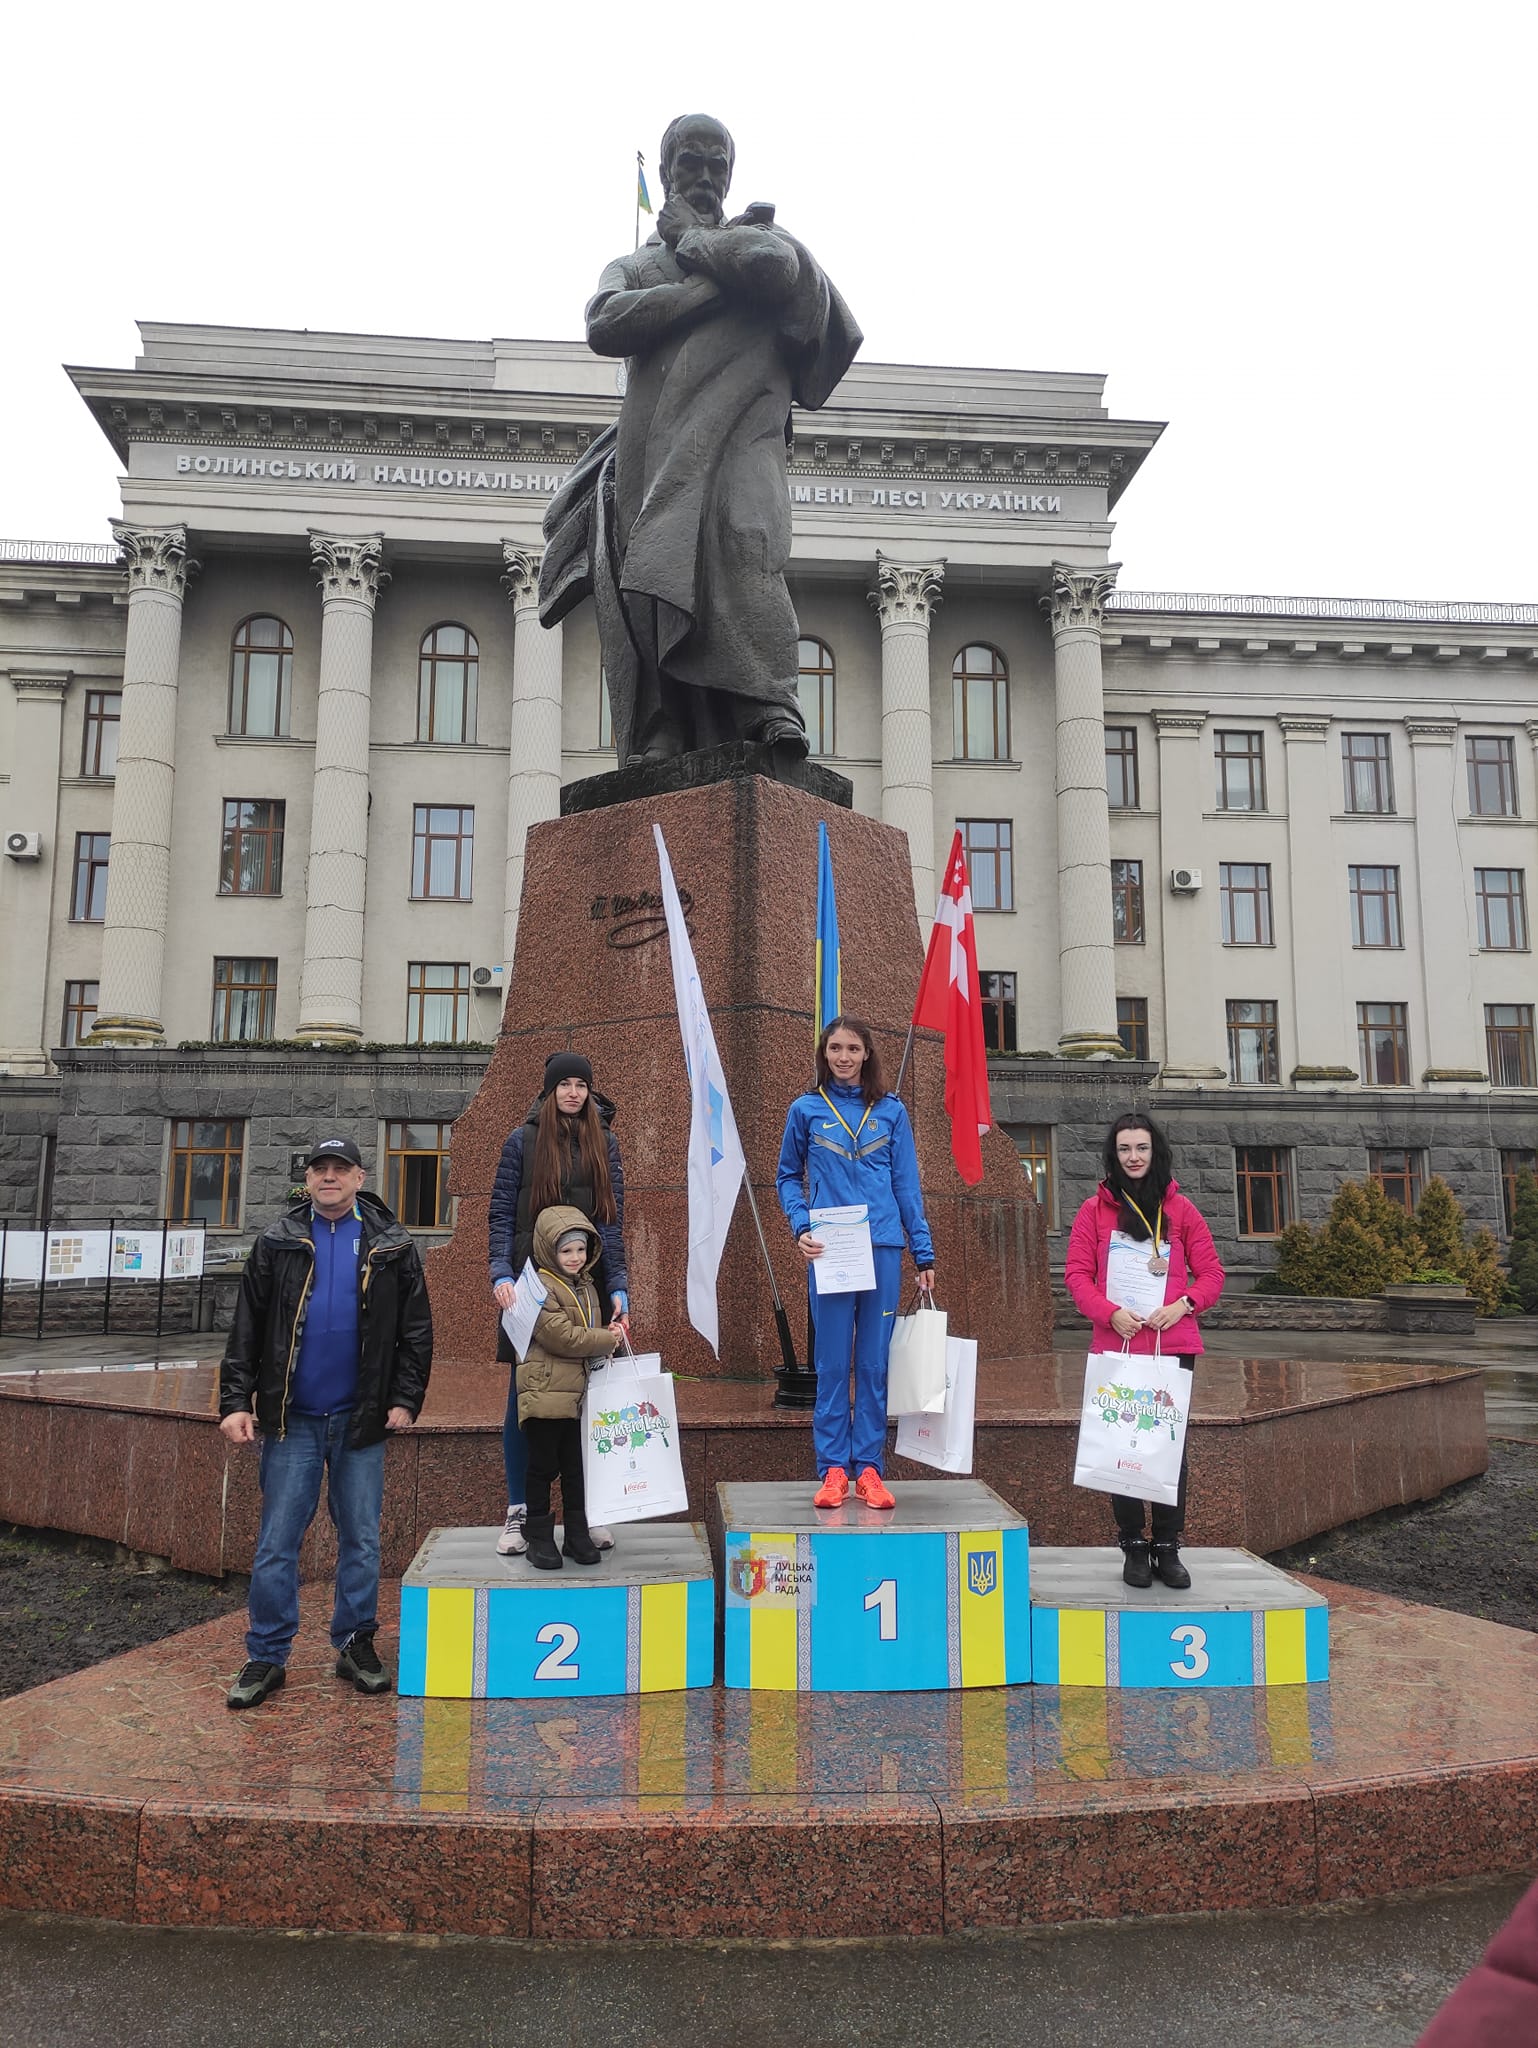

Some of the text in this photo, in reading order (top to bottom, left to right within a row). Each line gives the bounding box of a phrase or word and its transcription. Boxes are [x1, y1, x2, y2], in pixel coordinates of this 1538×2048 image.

[176, 454, 356, 481] ВОЛИНСЬКИЙ
[374, 465, 568, 491] НАЦІОНАЛЬНИ
[871, 489, 927, 508] ЛЕСІ
[940, 491, 1062, 513] УКРАЇНКИ
[774, 1573, 813, 1583] МІСЬКА
[774, 1585, 801, 1596] РАДА
[775, 1562, 815, 1574] ЛУЦЬКА
[864, 1579, 897, 1640] 1
[533, 1622, 580, 1680] 2
[1169, 1624, 1210, 1680] 3
